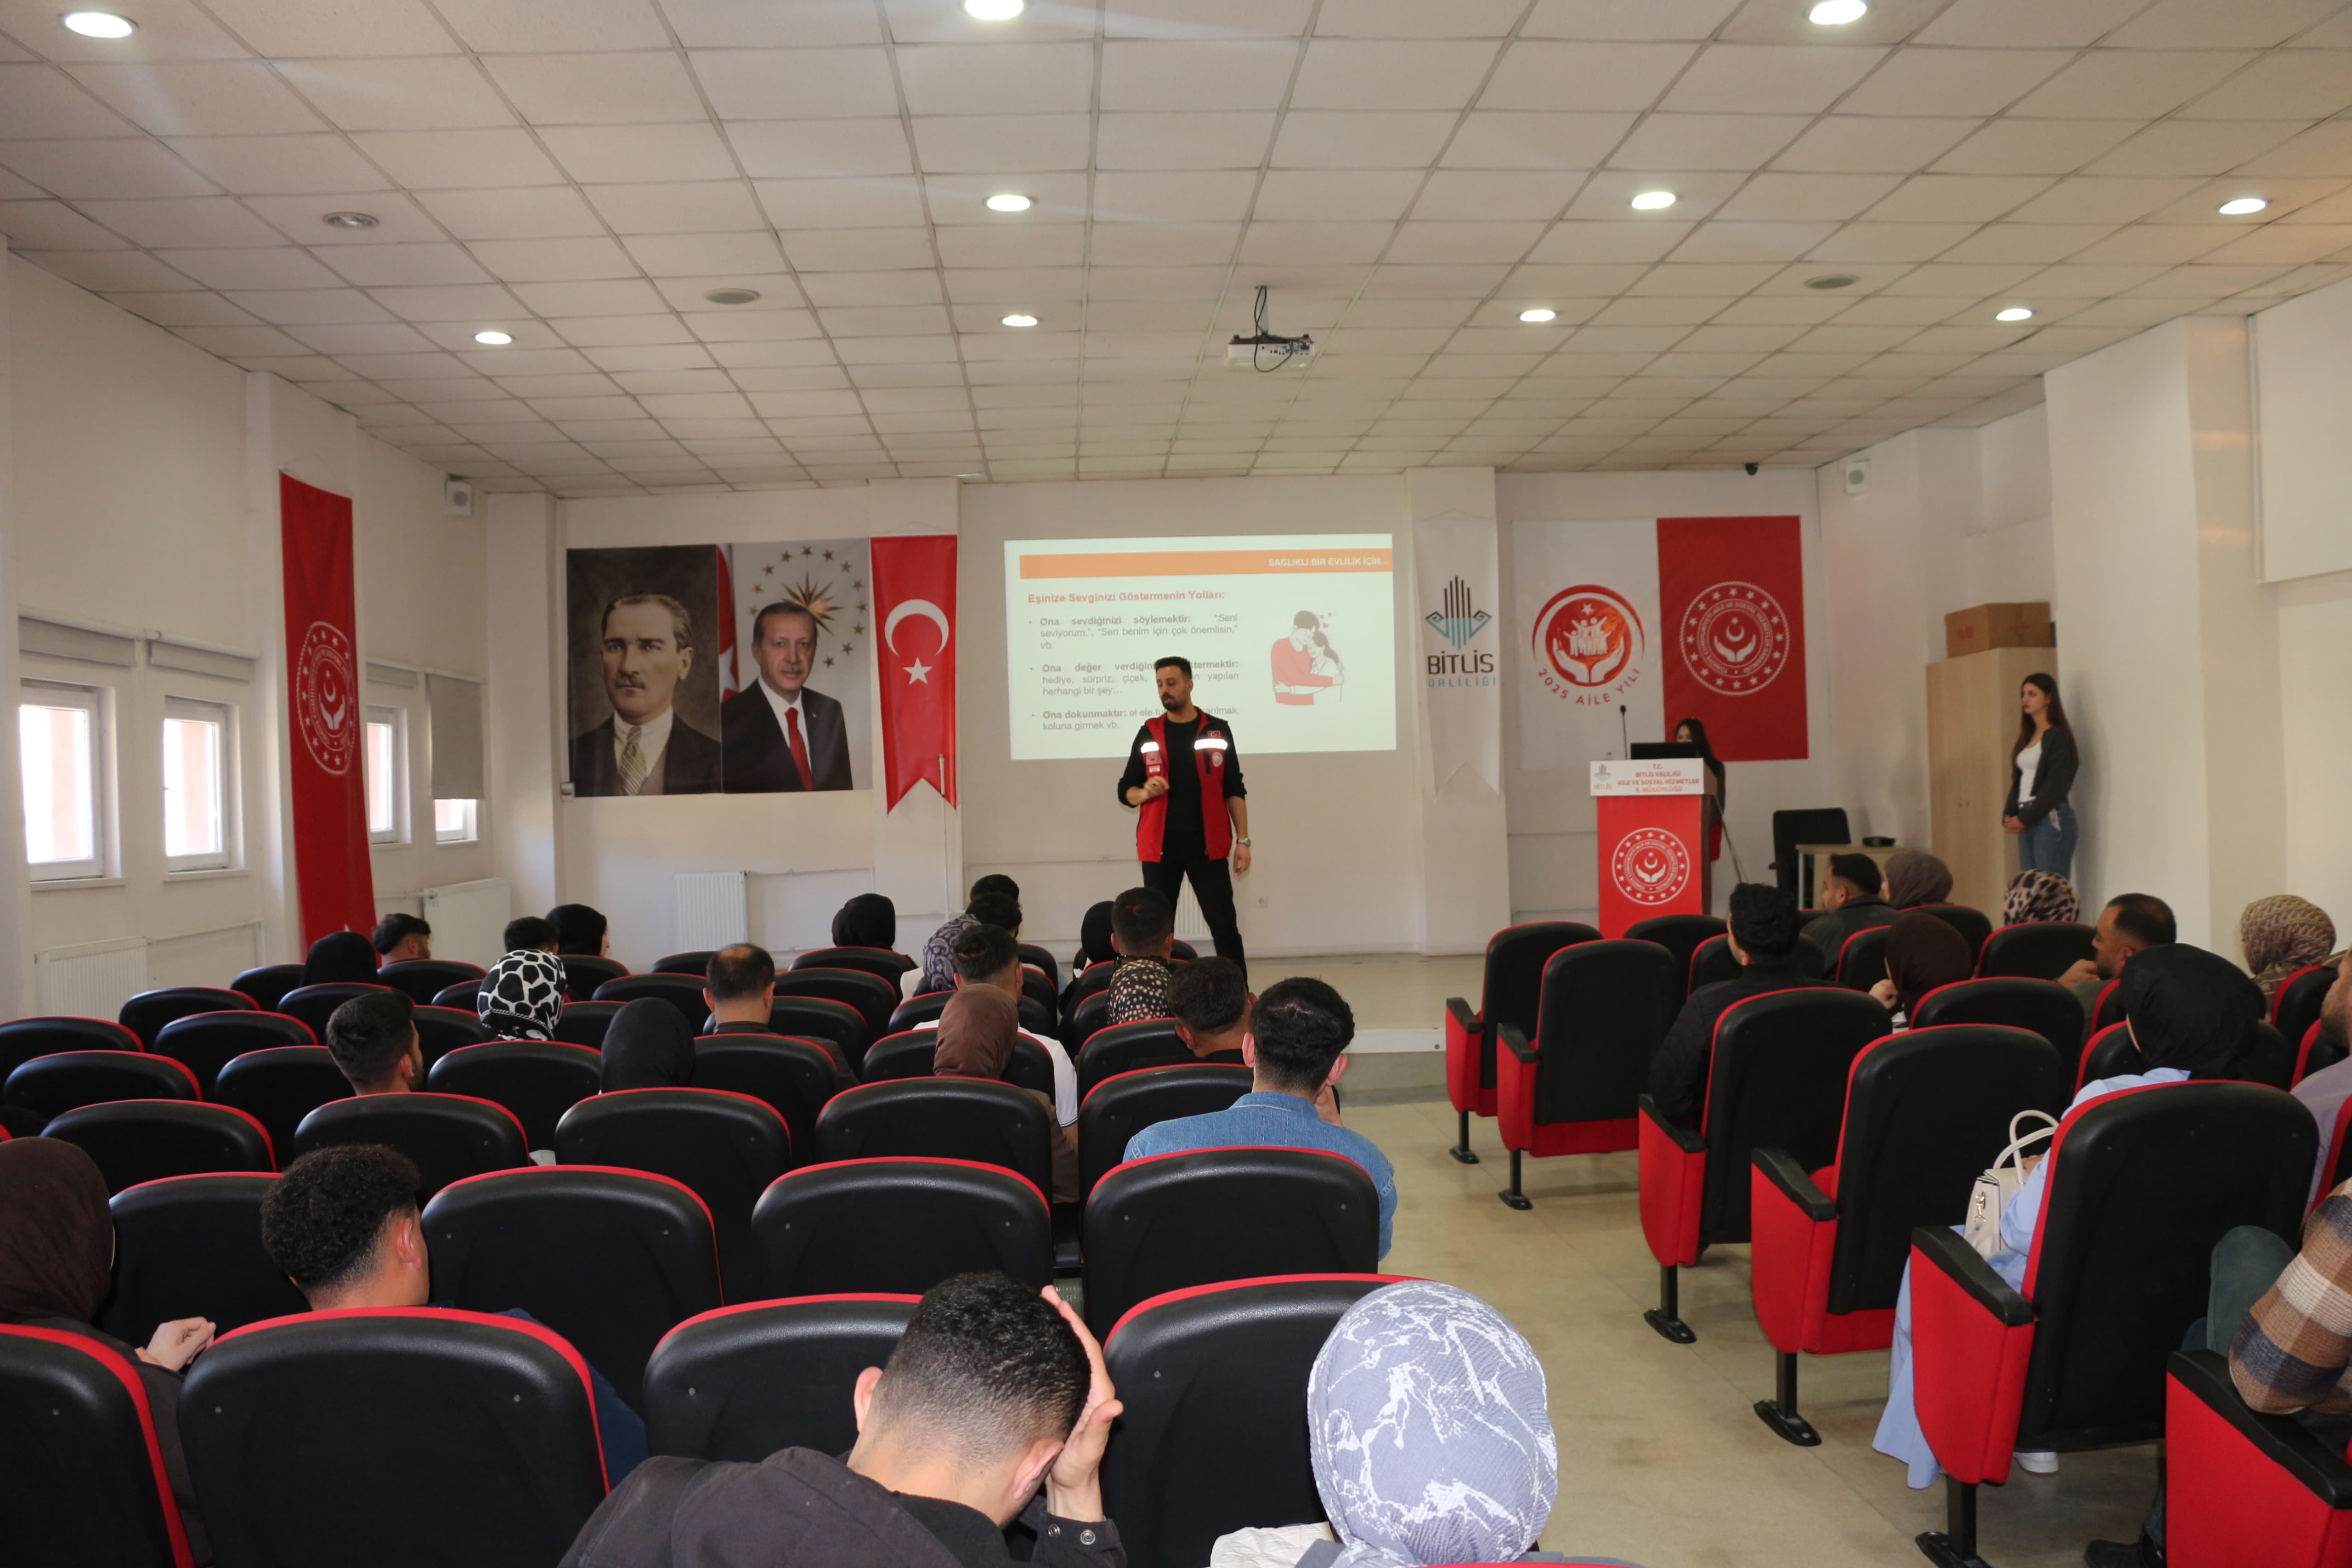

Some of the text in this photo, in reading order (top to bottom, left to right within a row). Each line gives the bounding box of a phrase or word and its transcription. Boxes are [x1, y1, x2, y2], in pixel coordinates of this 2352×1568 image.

[1268, 557, 1309, 566] SAĞLIKLI
[1312, 556, 1326, 566] BİR
[1329, 555, 1361, 565] EVLİLİK
[1028, 590, 1225, 604] Eşinize Sevginizi Göstermenin Yolları:
[1040, 617, 1059, 626] Ona
[1071, 616, 1121, 626] sevdiğinizi
[1134, 614, 1190, 625] söylemektir:
[1122, 627, 1149, 636] benim
[1153, 627, 1168, 637] için
[1171, 626, 1187, 636] çok
[1427, 649, 1494, 674] BİTLİS
[1075, 663, 1102, 673] değer
[1042, 675, 1074, 685] hediye,
[1082, 674, 1114, 684] sürpriz,
[1122, 674, 1147, 684] çiçek,
[1207, 671, 1239, 682] yapılan
[1043, 686, 1081, 696] herhangi
[1538, 668, 1640, 705] 2025 AİLE YILI
[1064, 709, 1126, 719] dokunmaktır:
[1129, 708, 1137, 717] el
[1139, 708, 1153, 716] ele
[1043, 722, 1072, 731] koluna
[1074, 721, 1104, 731] girmek
